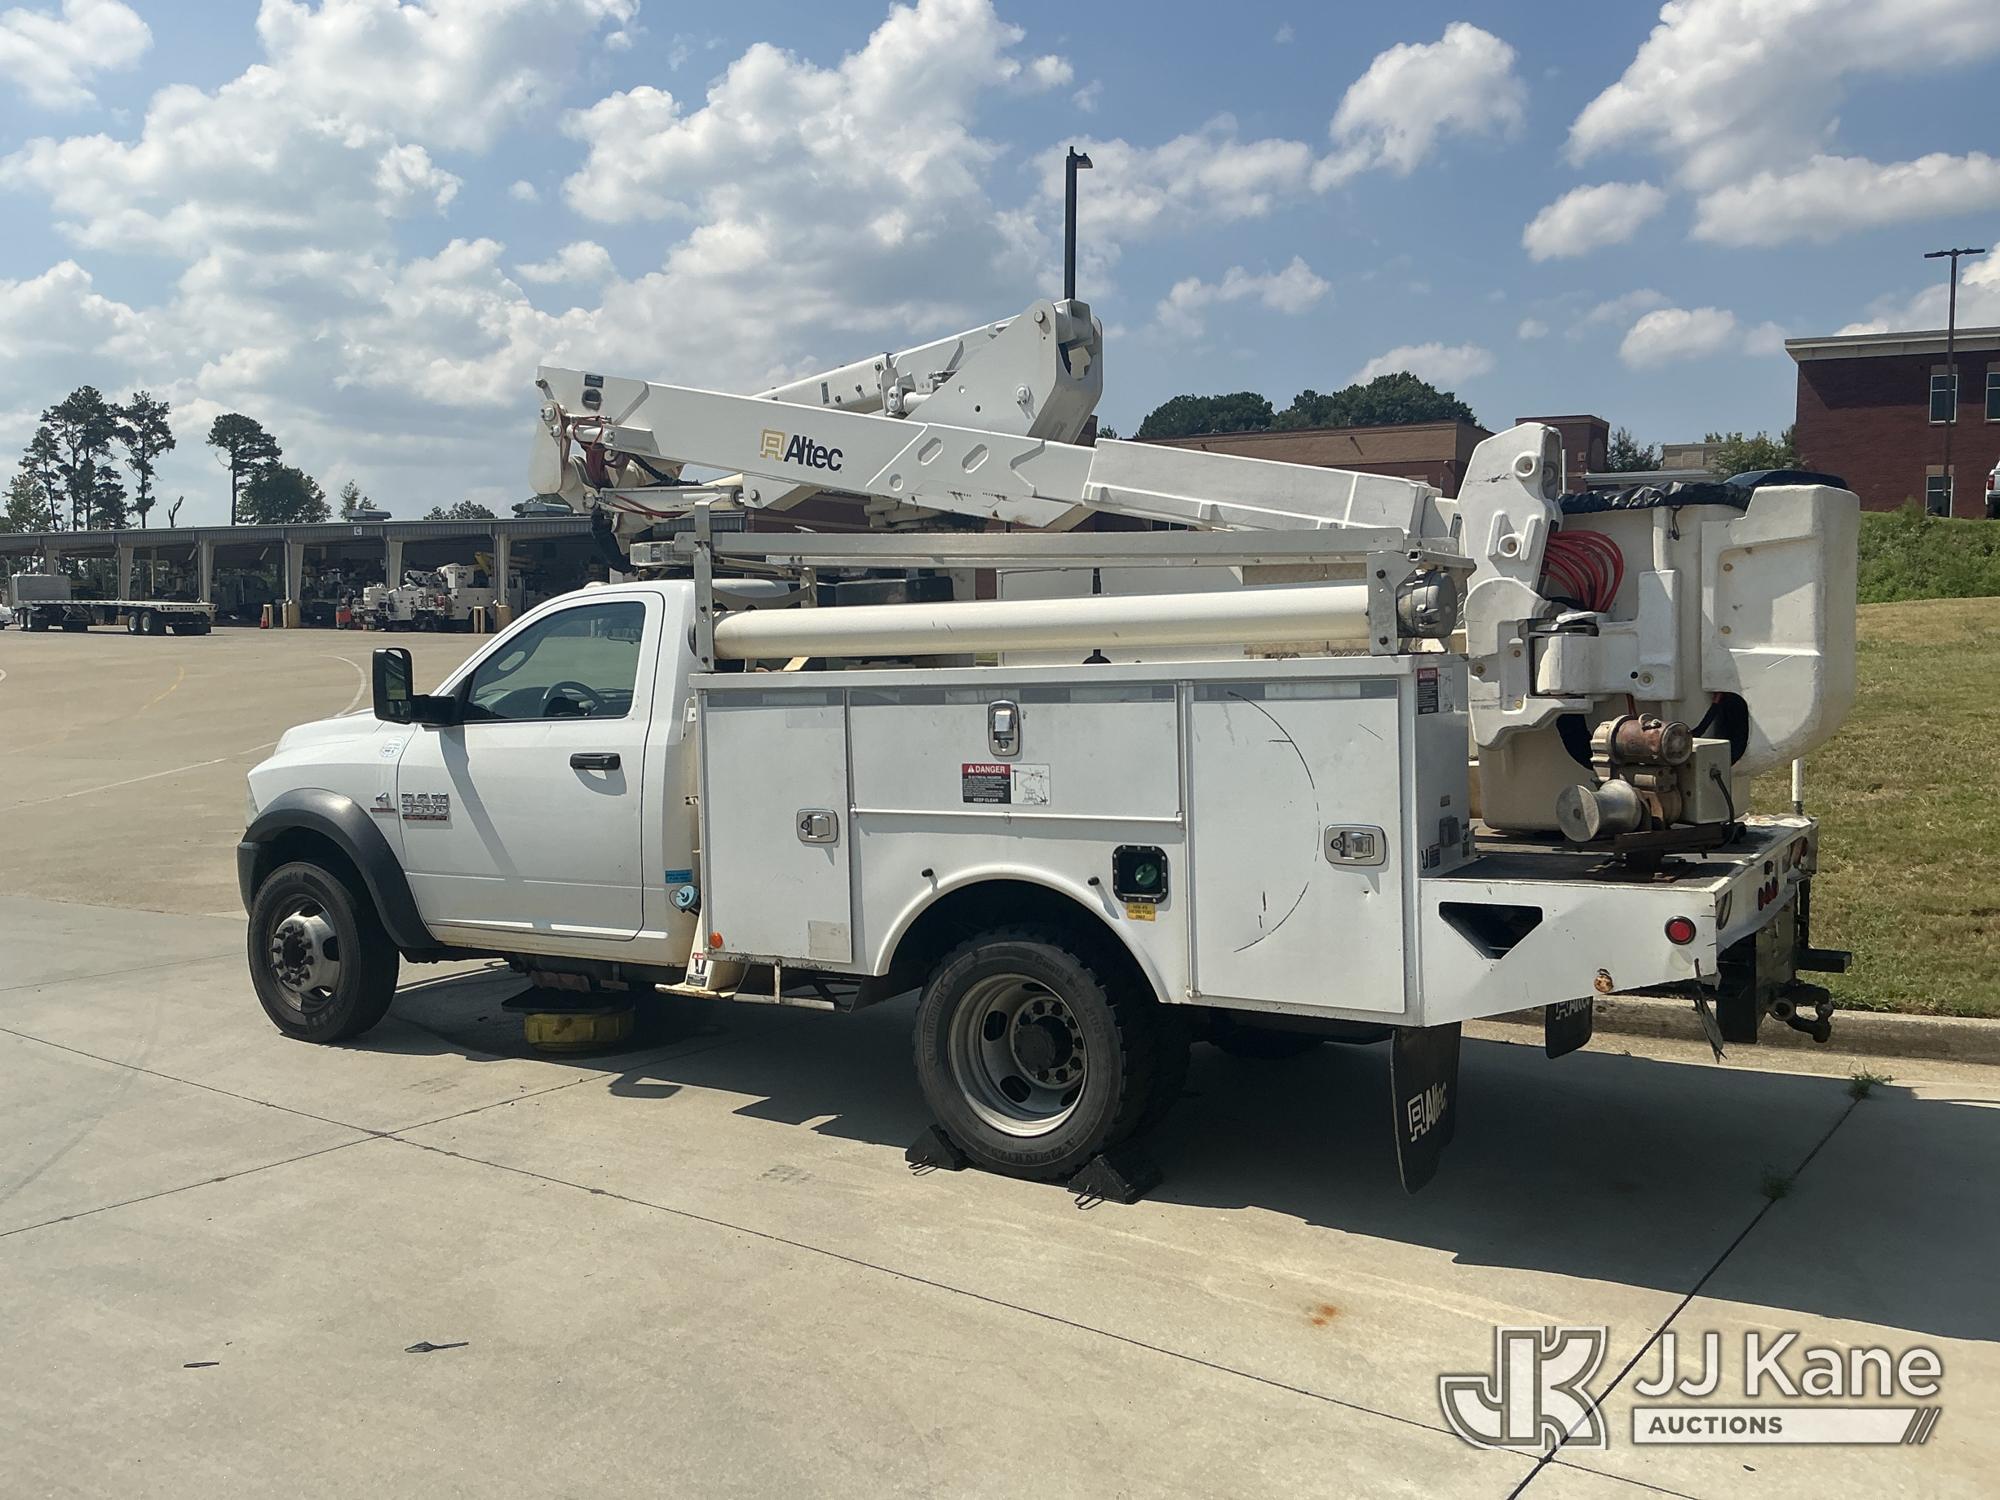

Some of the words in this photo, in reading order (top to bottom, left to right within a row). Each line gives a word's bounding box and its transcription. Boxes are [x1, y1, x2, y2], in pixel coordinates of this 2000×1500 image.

[783, 434, 843, 471] Altec
[975, 765, 1006, 774] DANGER
[401, 792, 449, 804] RAM
[1425, 1081, 1448, 1131] Altec
